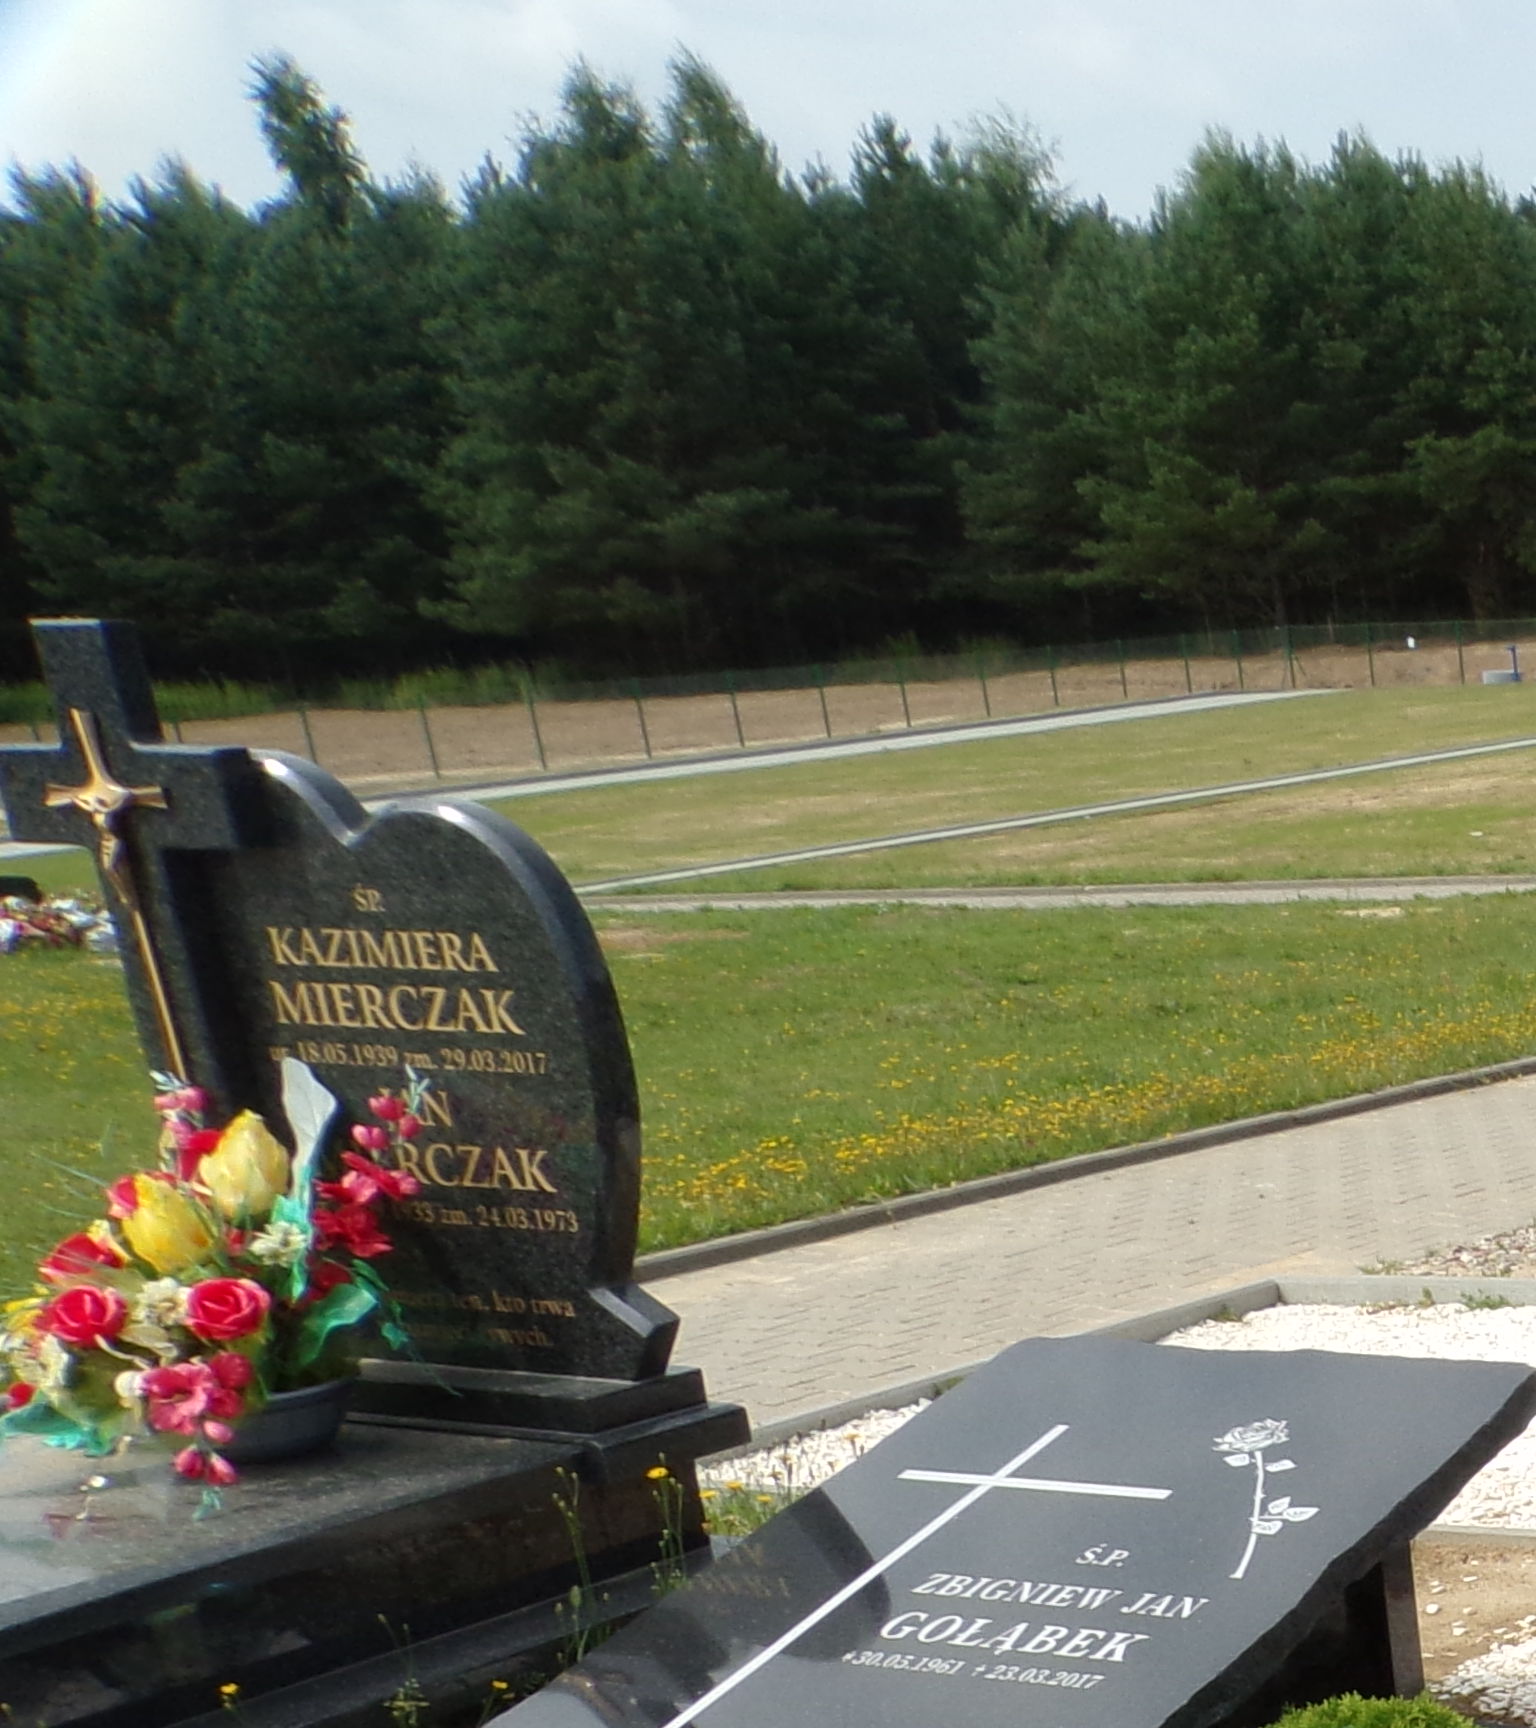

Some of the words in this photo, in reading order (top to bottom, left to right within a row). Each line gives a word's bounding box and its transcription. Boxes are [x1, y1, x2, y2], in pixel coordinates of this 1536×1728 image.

[265, 926, 499, 973] KAZIMIERA
[268, 980, 527, 1036] MIERCZAK
[440, 1047, 549, 1076] 29.03.2017
[396, 1141, 558, 1194] RCZAK
[1075, 1543, 1131, 1568] Ś.P.
[909, 1573, 1123, 1612] ZBIGNIEW
[1120, 1592, 1210, 1620] JAN
[880, 1610, 1151, 1663] GOŁĄBEK
